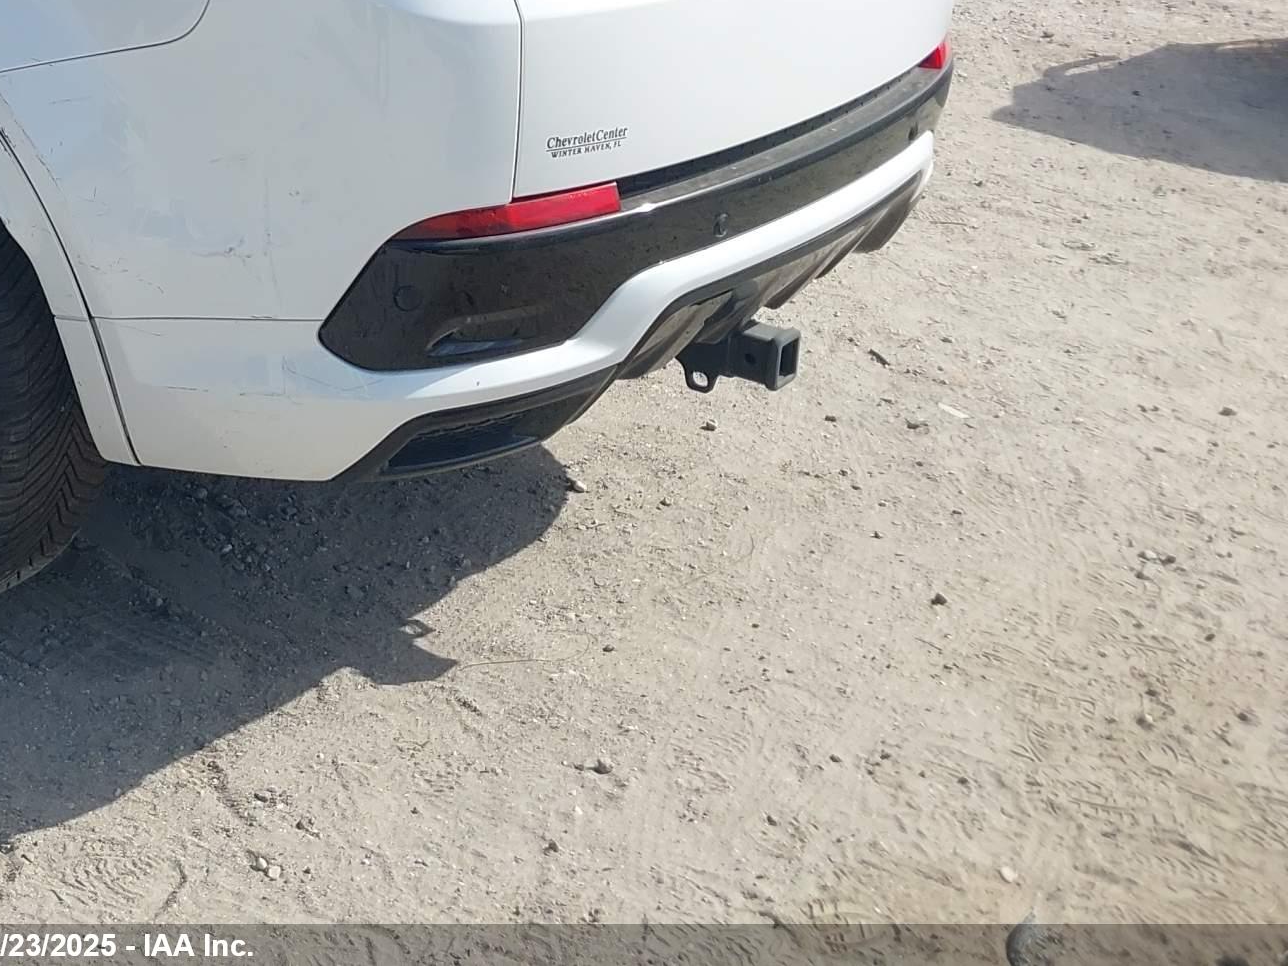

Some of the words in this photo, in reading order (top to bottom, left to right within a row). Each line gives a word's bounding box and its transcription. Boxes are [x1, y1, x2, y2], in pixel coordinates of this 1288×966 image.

[584, 142, 612, 154] HAVEN,
[613, 140, 621, 148] FL
[551, 147, 582, 158] WINTER
